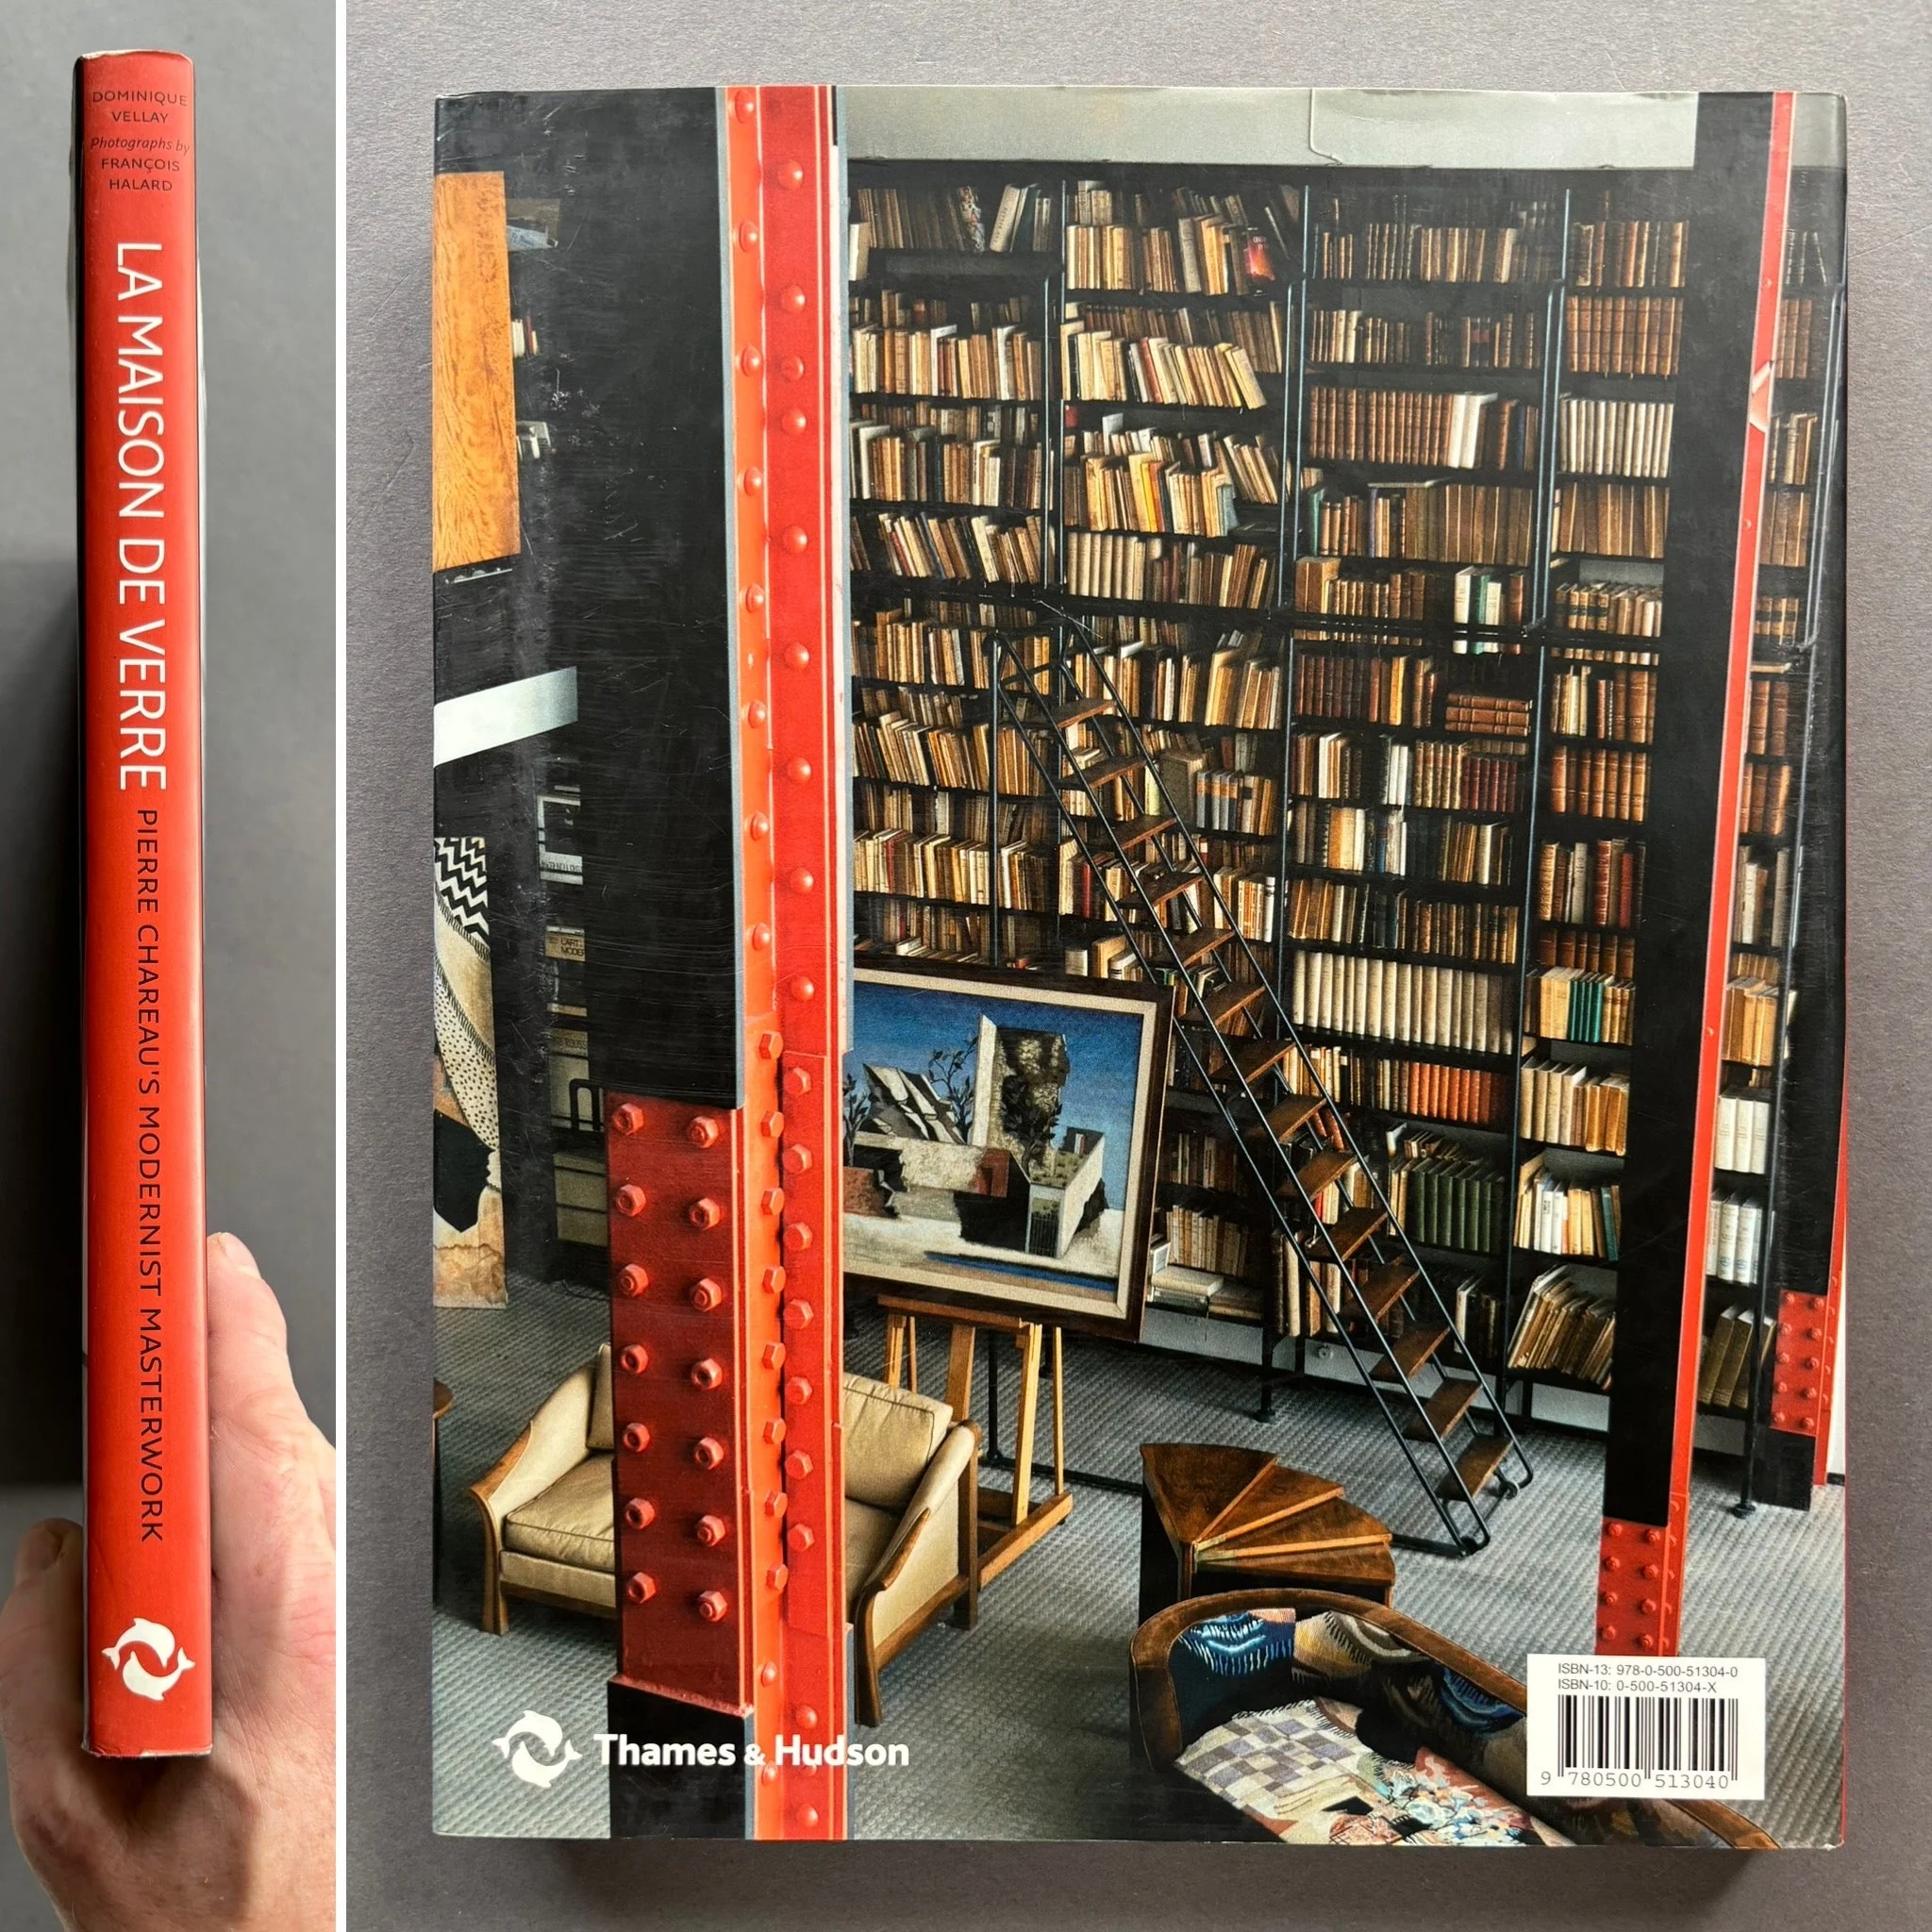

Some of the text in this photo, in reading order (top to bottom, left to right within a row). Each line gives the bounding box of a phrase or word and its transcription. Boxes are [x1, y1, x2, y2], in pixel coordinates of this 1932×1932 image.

[92, 91, 188, 107] DOMINIQUE
[111, 111, 169, 124] VELLAY
[90, 137, 191, 156] Photographs by
[101, 158, 180, 173] FRANÇOIS
[108, 179, 173, 192] HALARD
[117, 242, 166, 790] LA MAISON DE VERRE
[137, 809, 162, 1542] PIERRE CHAREAU'S MODERNIST MASTERWORK
[1557, 1662, 1739, 1678] ISBN-13: 978-0-500-51304-0
[1557, 1678, 1717, 1693] ISBN-10: 0-500-51304-X
[593, 1733, 910, 1767] Thames & Hudson
[1541, 1771, 1729, 1790] 9 780500 513040
